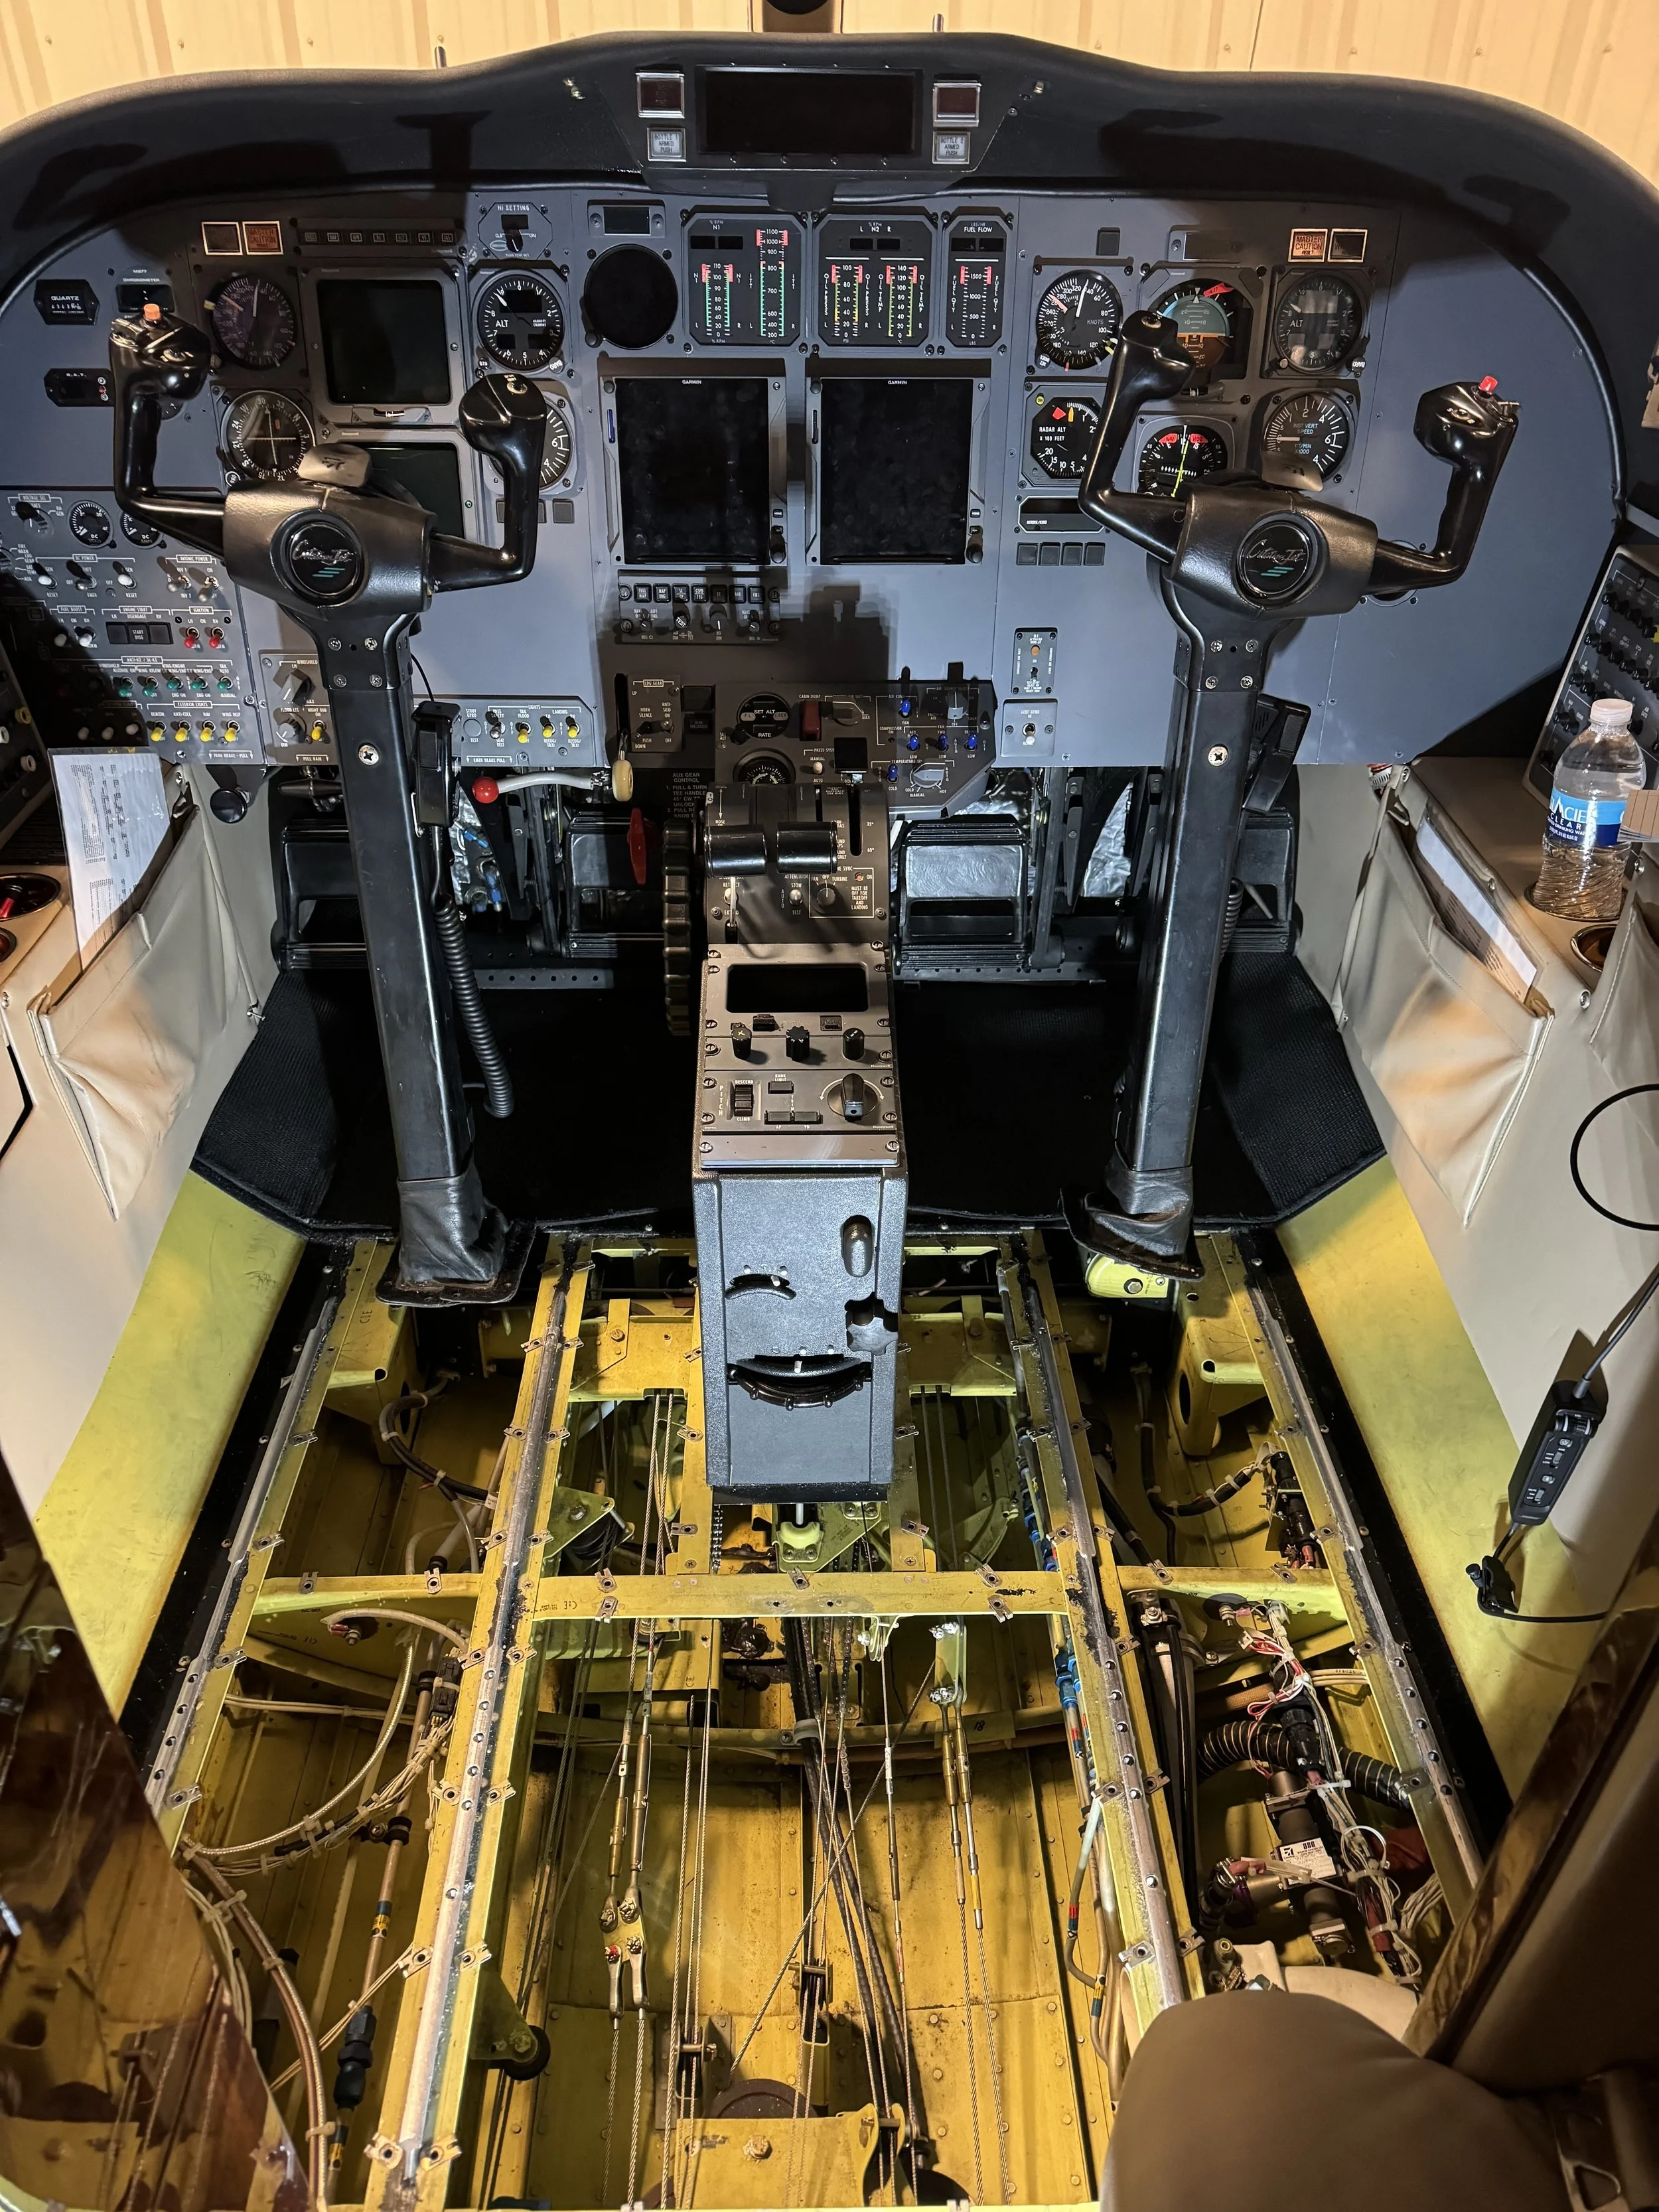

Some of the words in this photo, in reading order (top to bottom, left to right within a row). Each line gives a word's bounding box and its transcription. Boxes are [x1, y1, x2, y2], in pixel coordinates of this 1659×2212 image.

[1295, 235, 1323, 244] MASTER
[232, 419, 240, 429] 24
[233, 441, 240, 449] 21
[676, 617, 686, 627] TEST
[1550, 813, 1581, 830] CLEAR
